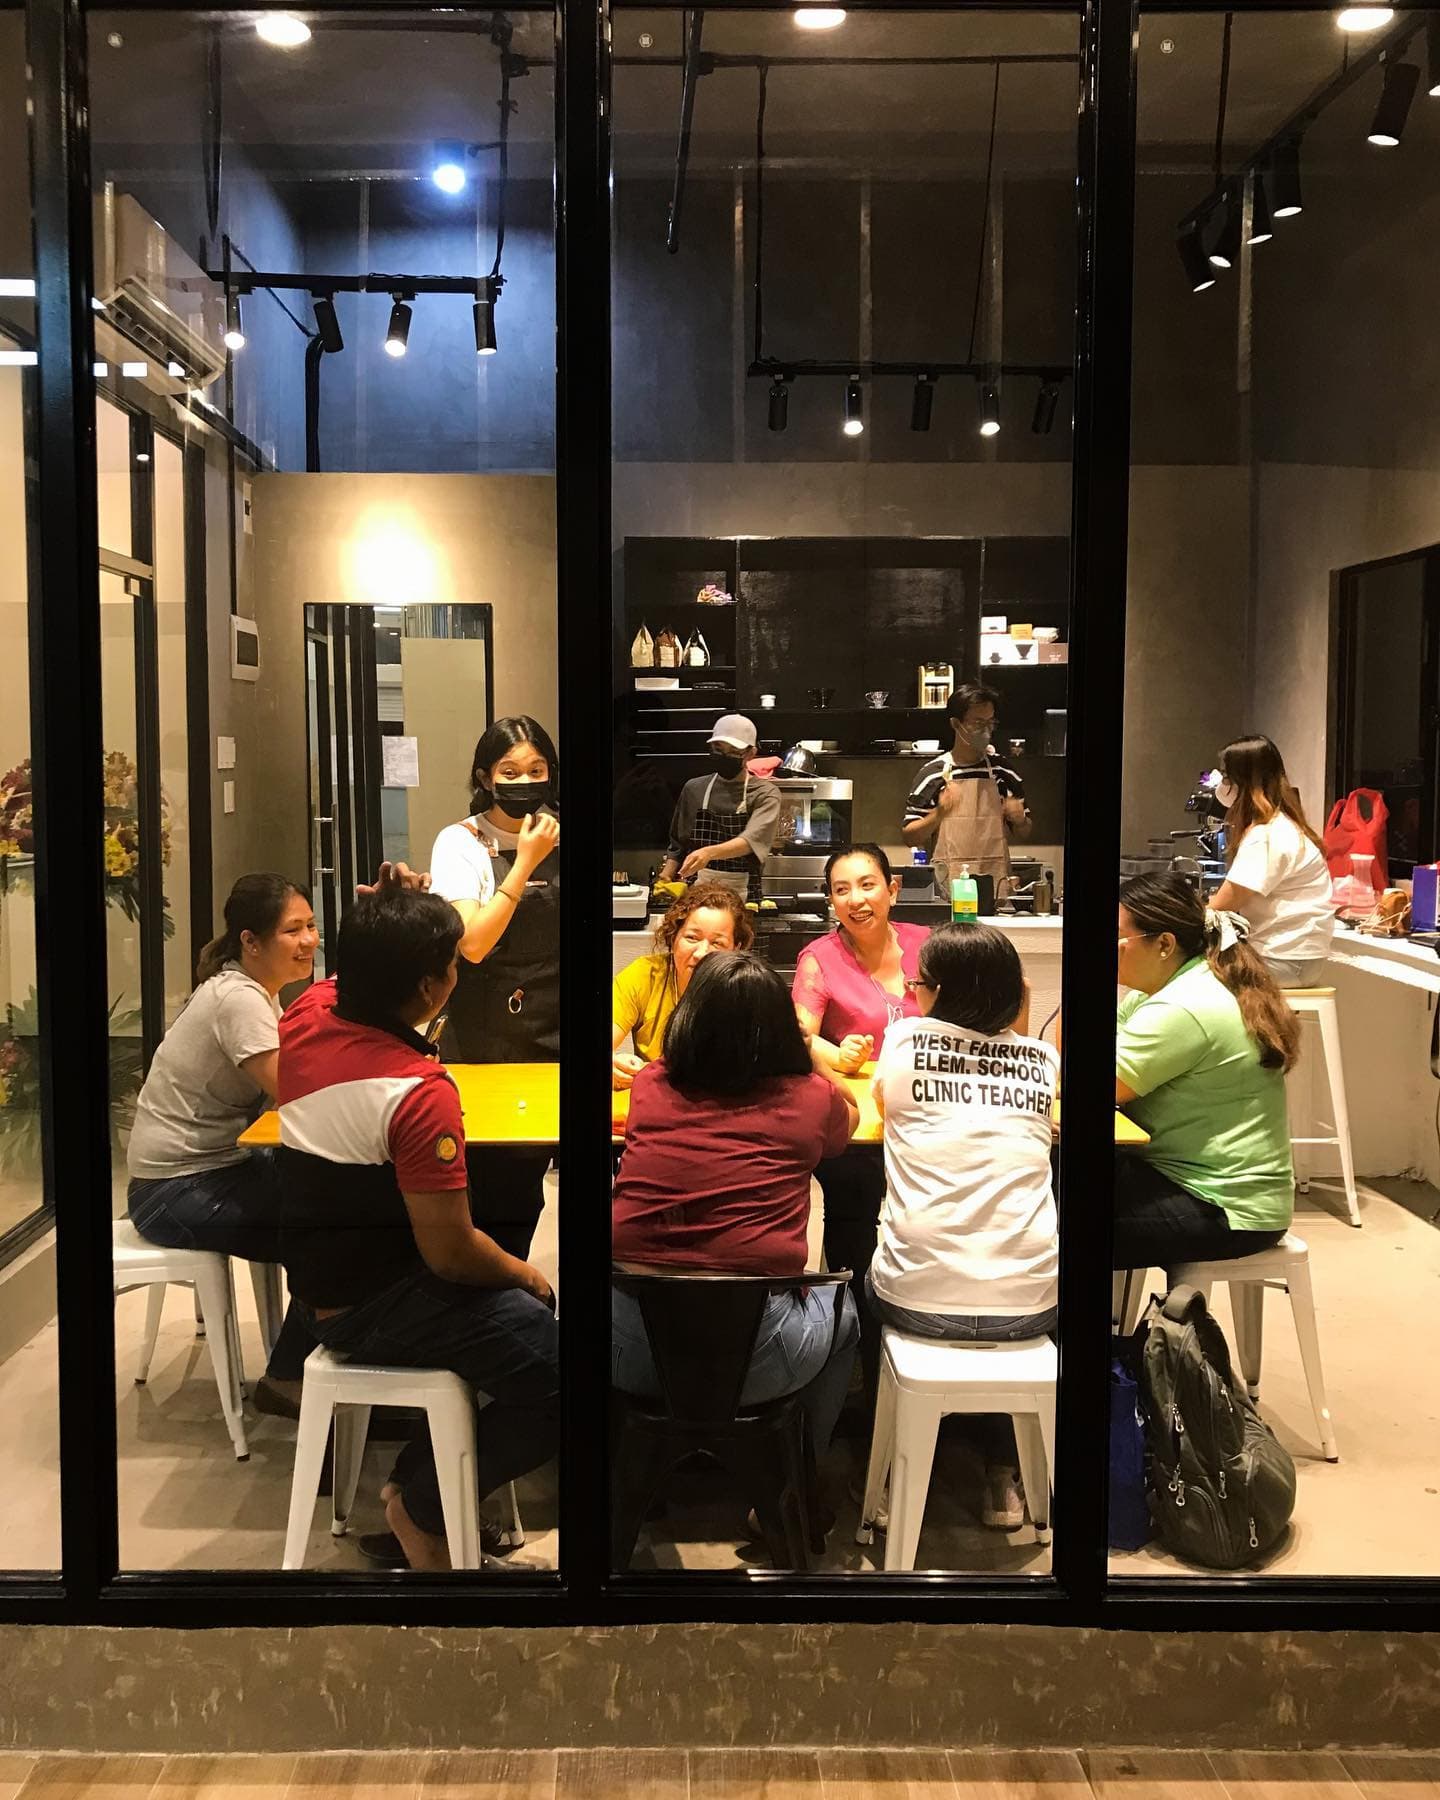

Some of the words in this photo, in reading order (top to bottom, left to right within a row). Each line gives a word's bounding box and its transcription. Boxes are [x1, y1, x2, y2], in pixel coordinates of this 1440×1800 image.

[912, 1033, 965, 1054] WEST
[969, 1040, 1047, 1066] FAIRVIEW
[913, 1052, 971, 1075] ELEM.
[977, 1058, 1050, 1087] SCHOOL
[911, 1078, 973, 1105] CLINIC
[978, 1083, 1052, 1118] TEACHER
